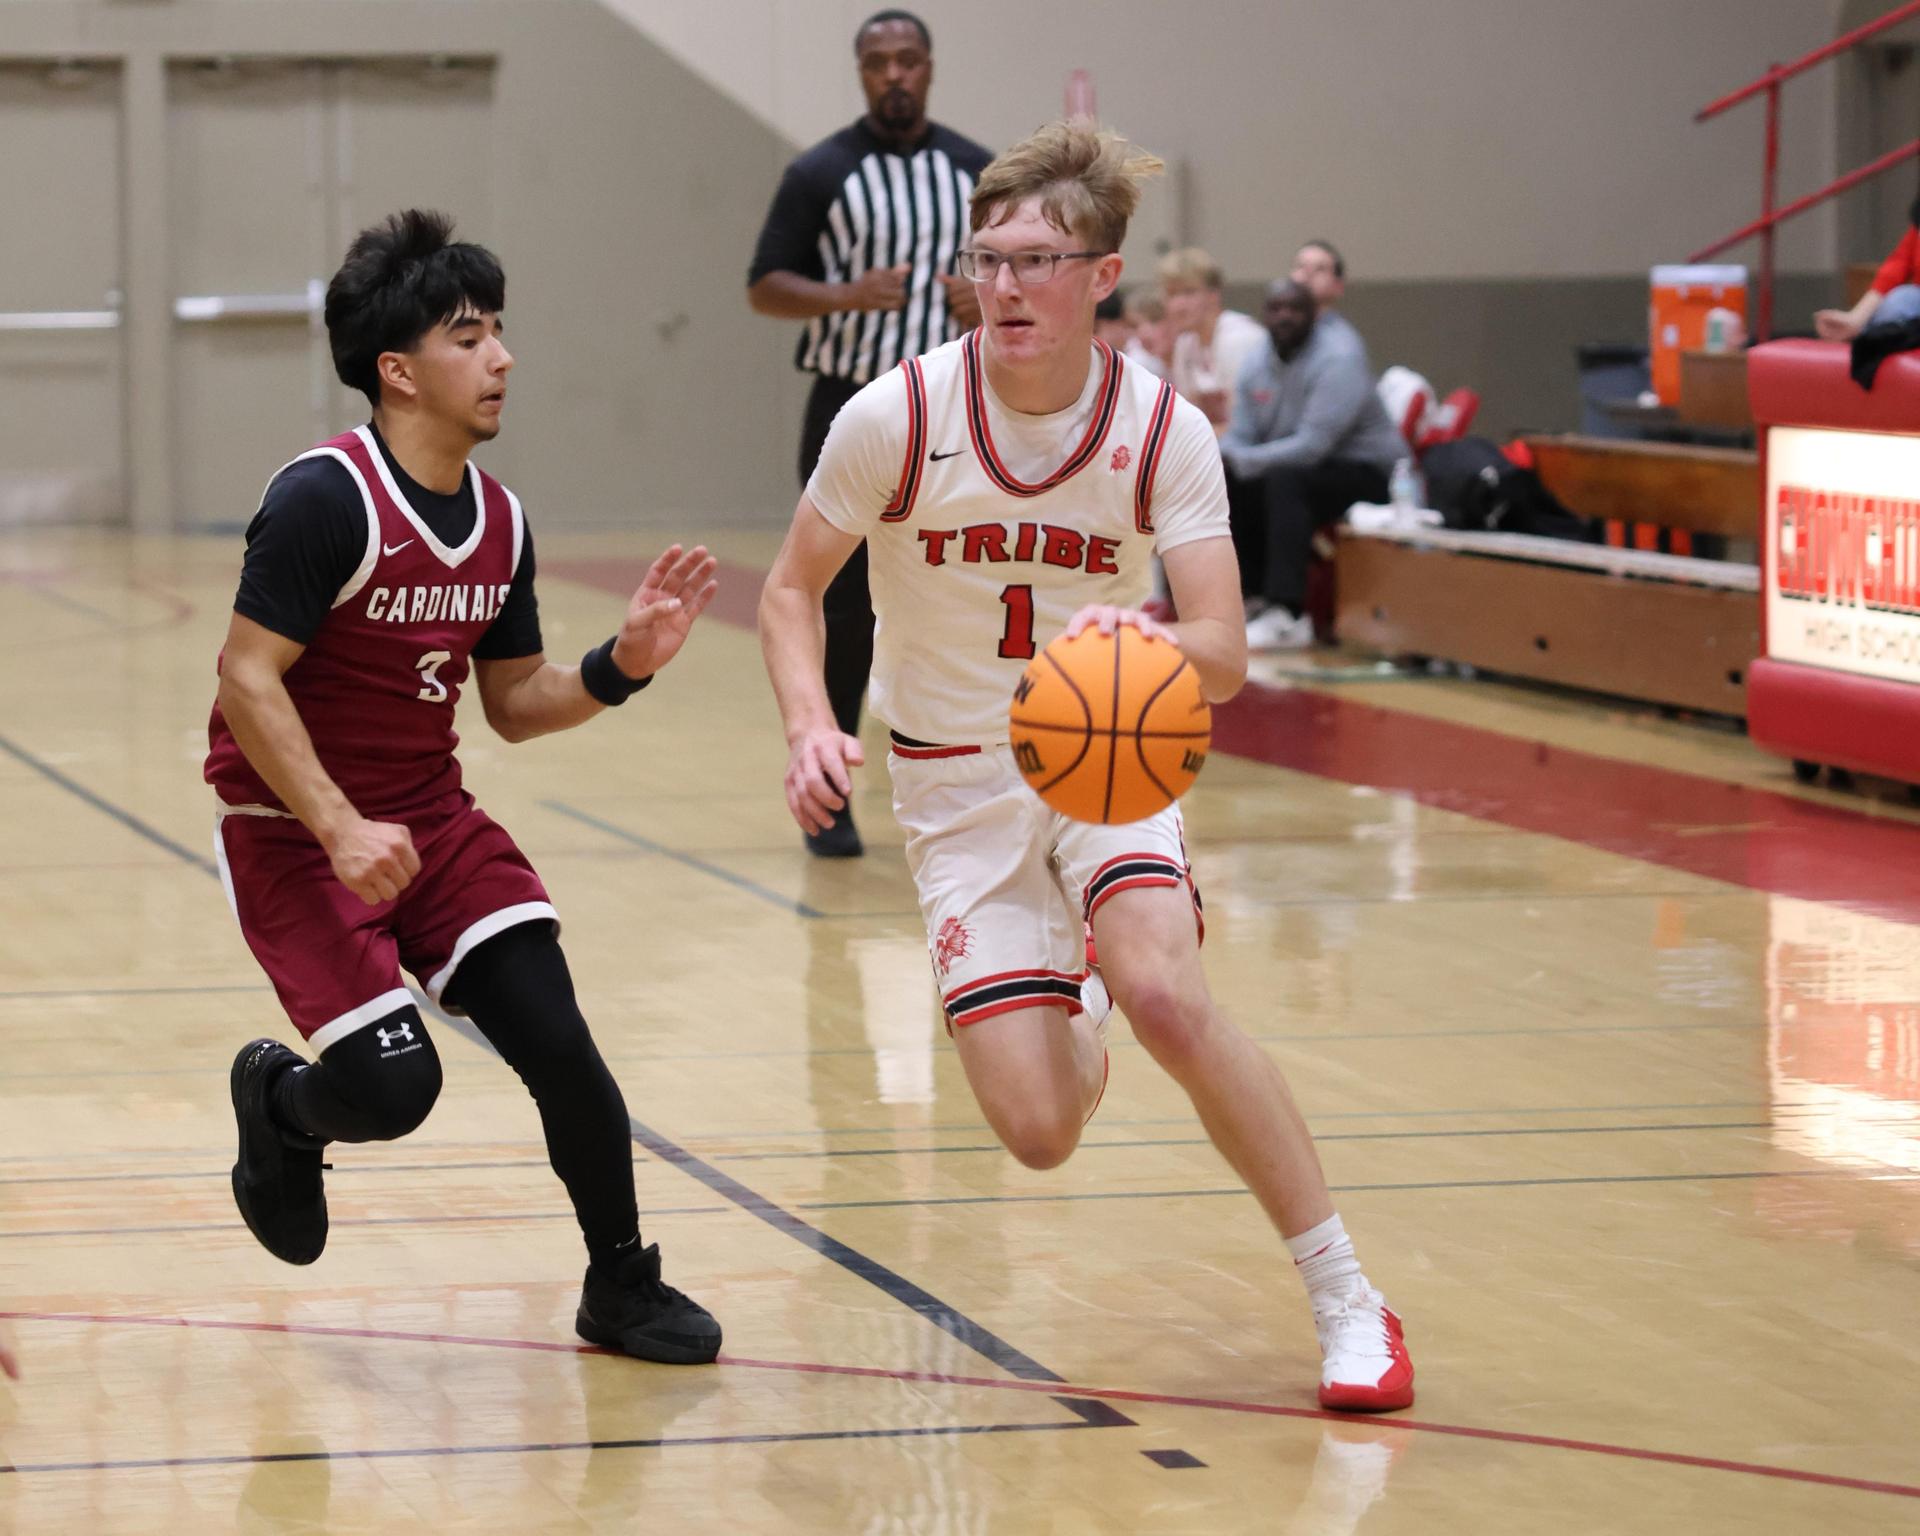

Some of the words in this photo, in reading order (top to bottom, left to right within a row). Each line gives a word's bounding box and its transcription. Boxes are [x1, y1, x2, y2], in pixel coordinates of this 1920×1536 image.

[917, 522, 1122, 574] TRIBE
[366, 584, 511, 623] CARDINALS
[997, 584, 1036, 660] 1
[1805, 617, 1850, 655] HIGH
[415, 650, 451, 703] 3
